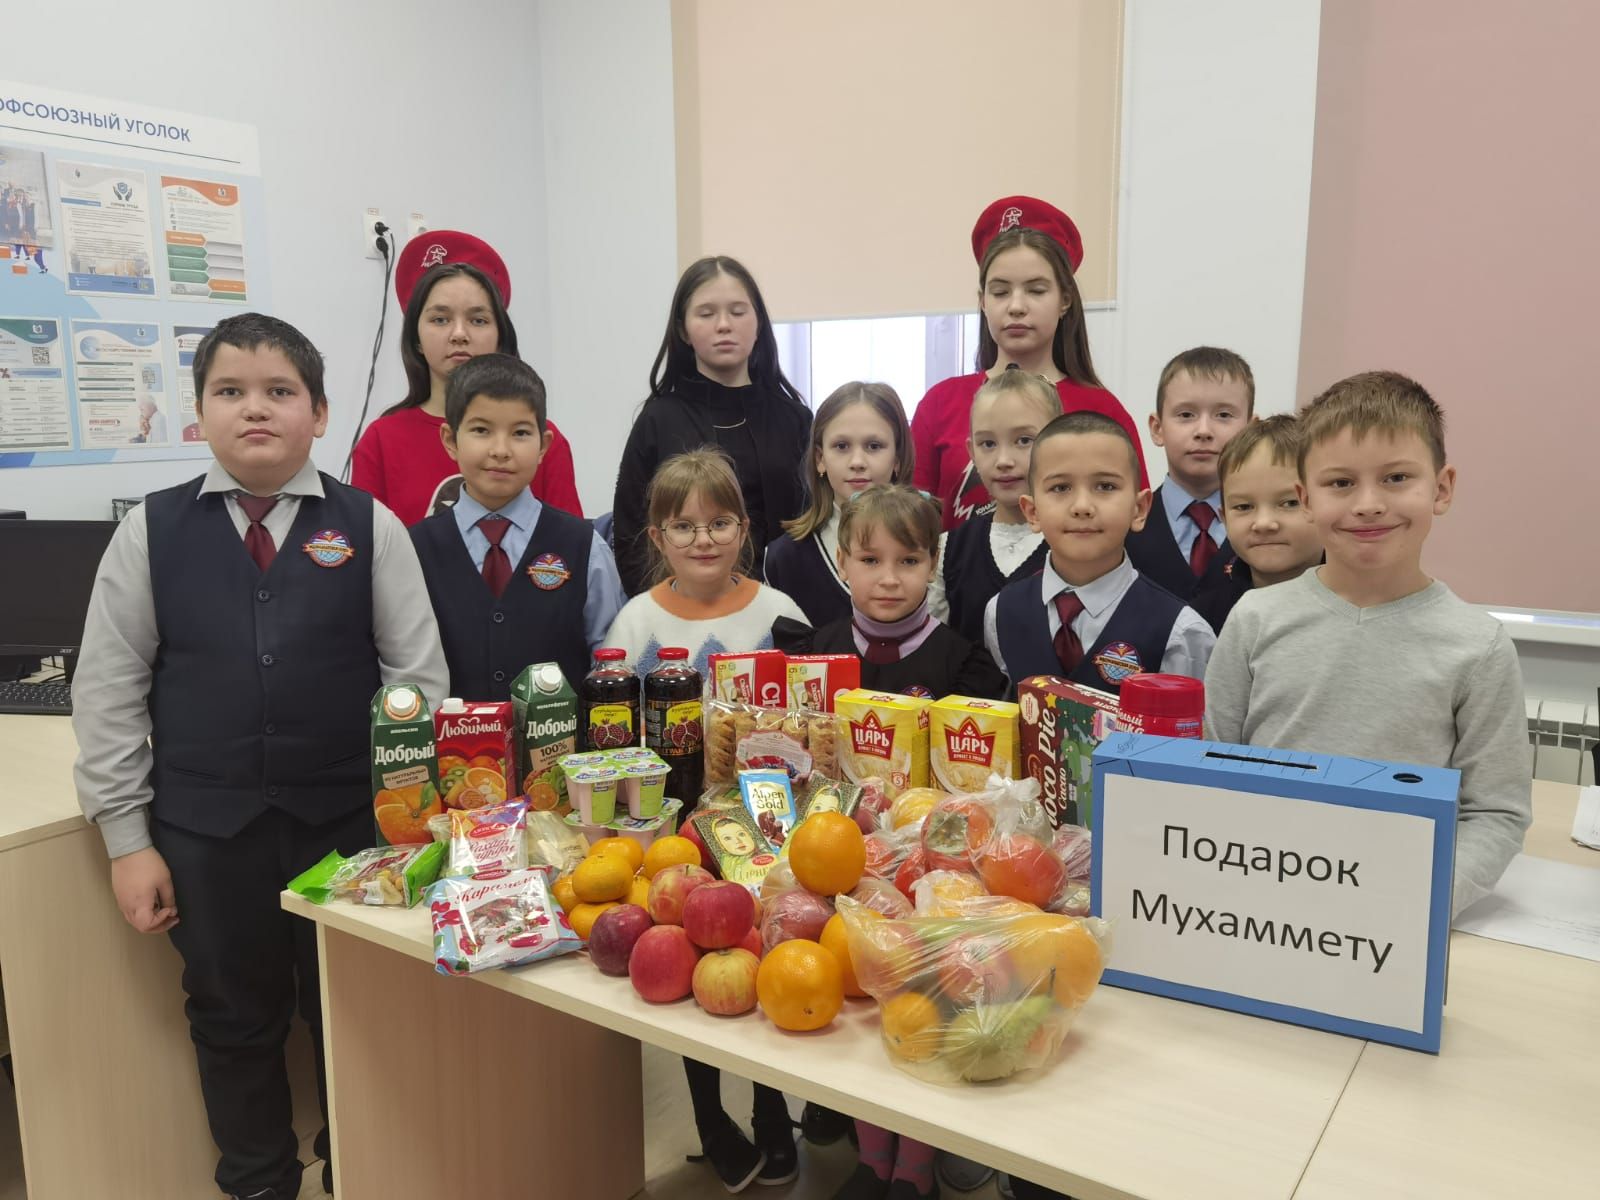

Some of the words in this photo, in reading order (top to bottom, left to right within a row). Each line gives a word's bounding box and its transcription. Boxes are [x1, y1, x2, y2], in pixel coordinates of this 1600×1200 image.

[125, 118, 191, 142] УГОЛОК
[437, 717, 503, 741] Любимый
[526, 713, 577, 739] Добрый
[855, 727, 890, 747] ЦАРЬ
[1038, 707, 1056, 765] Pie
[374, 740, 436, 766] Добрый
[540, 742, 568, 758] 100%
[950, 734, 990, 754] ЦАРЬ
[752, 788, 785, 802] Alpen
[1057, 767, 1068, 810] Cacao
[1162, 824, 1360, 887] Подарок
[1131, 888, 1393, 974] Мухаммету
